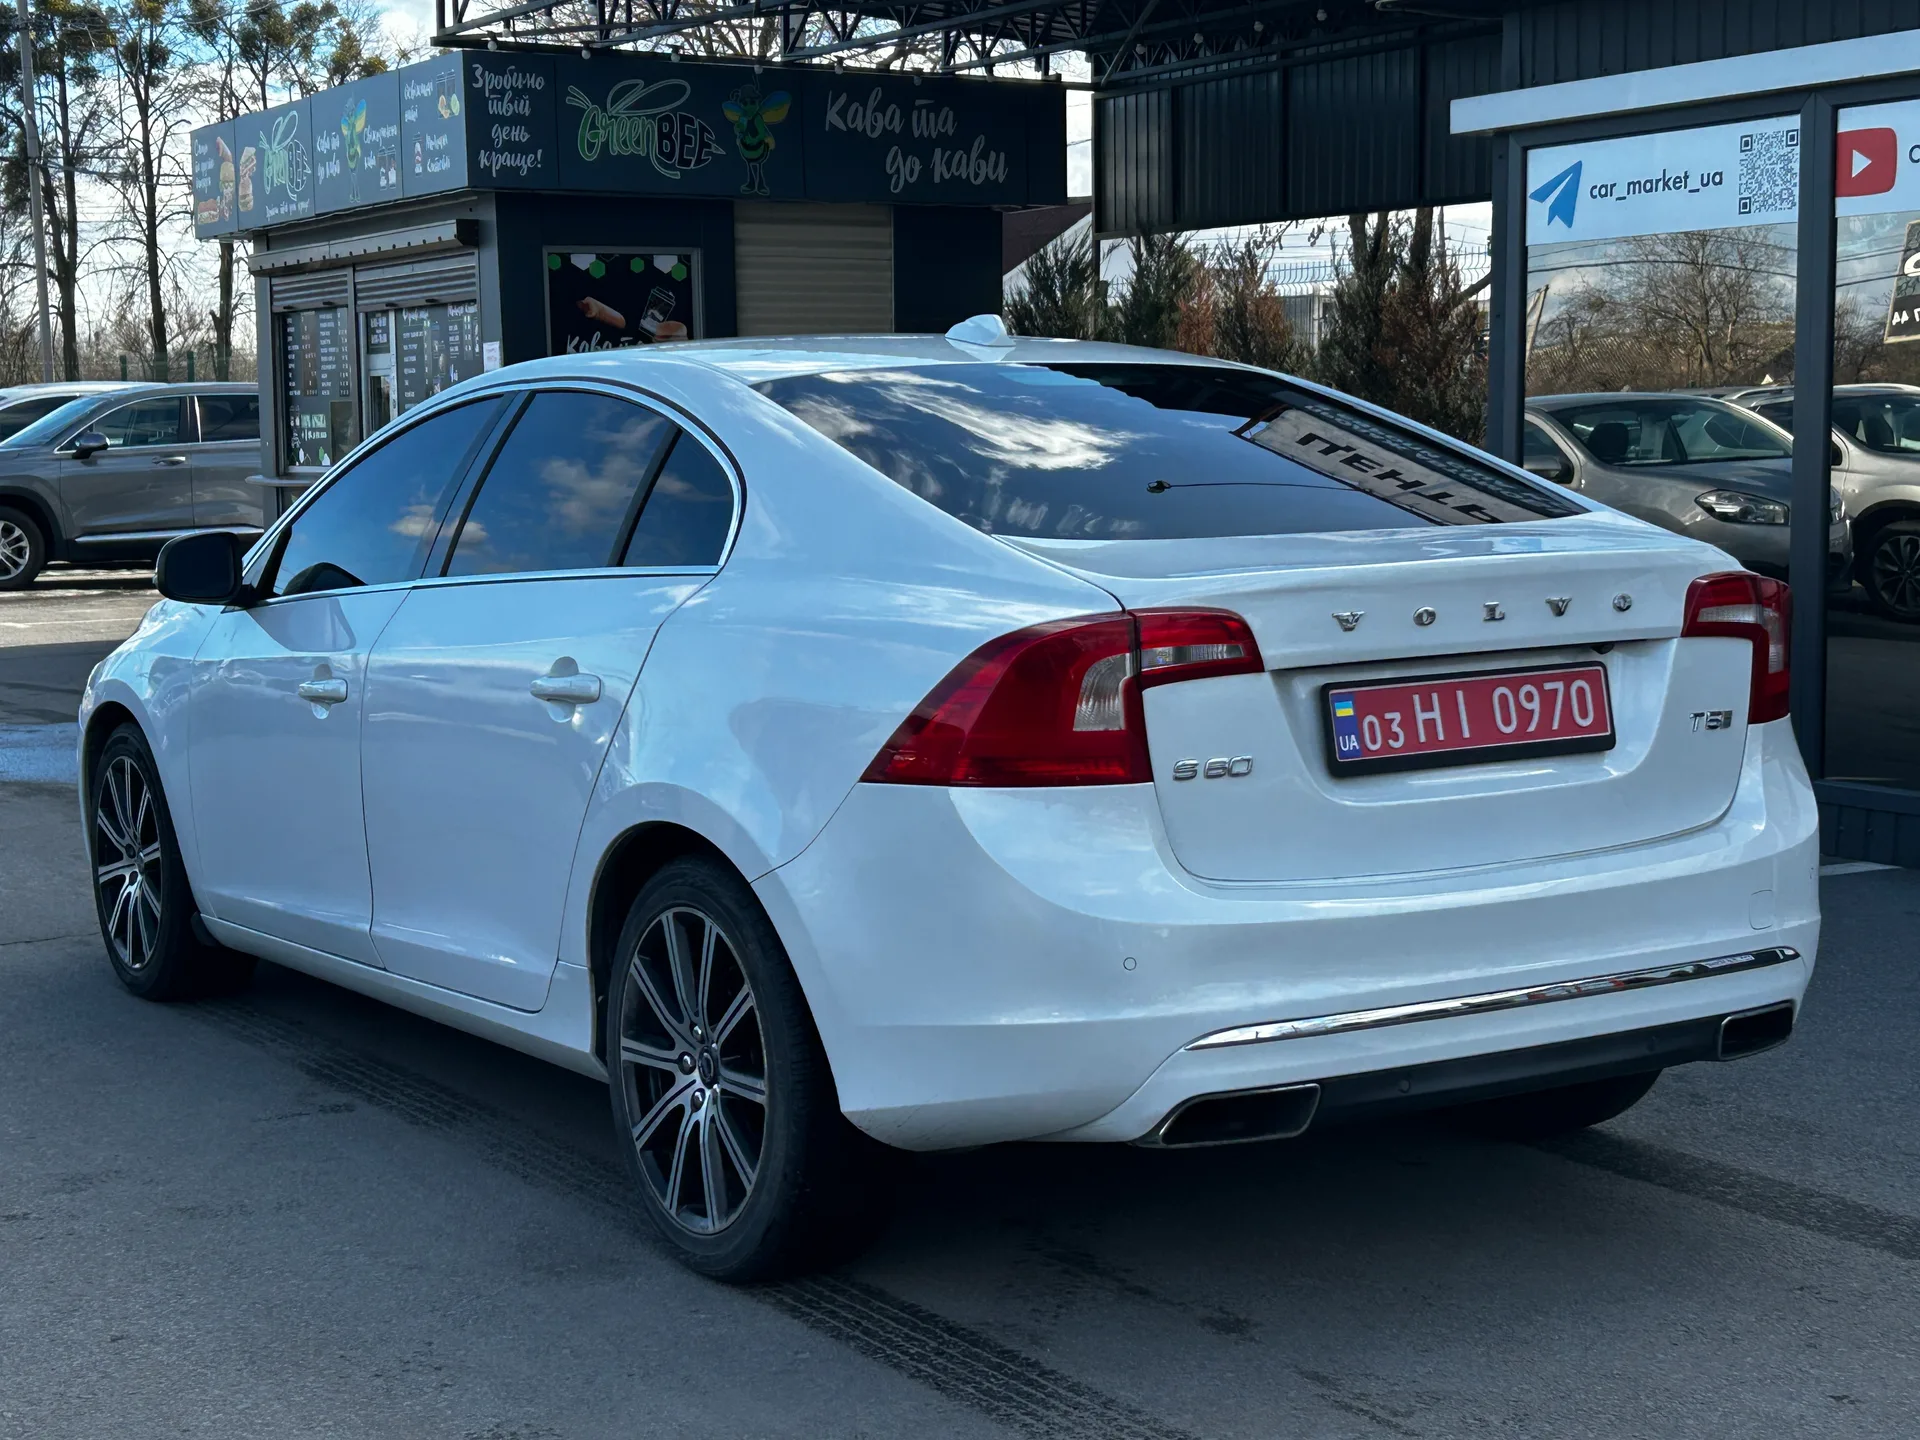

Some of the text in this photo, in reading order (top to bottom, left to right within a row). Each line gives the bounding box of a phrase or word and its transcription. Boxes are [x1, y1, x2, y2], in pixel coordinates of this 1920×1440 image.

[488, 90, 532, 117] твій
[825, 87, 957, 138] Кава та
[491, 123, 531, 149] день
[477, 148, 543, 178] краще!
[885, 135, 1009, 193] до кави
[1589, 168, 1724, 202] car_market_ua
[1331, 592, 1633, 632] VOLVO
[1362, 711, 1405, 751] 03
[1491, 679, 1596, 735] 0970
[1339, 734, 1360, 752] UA
